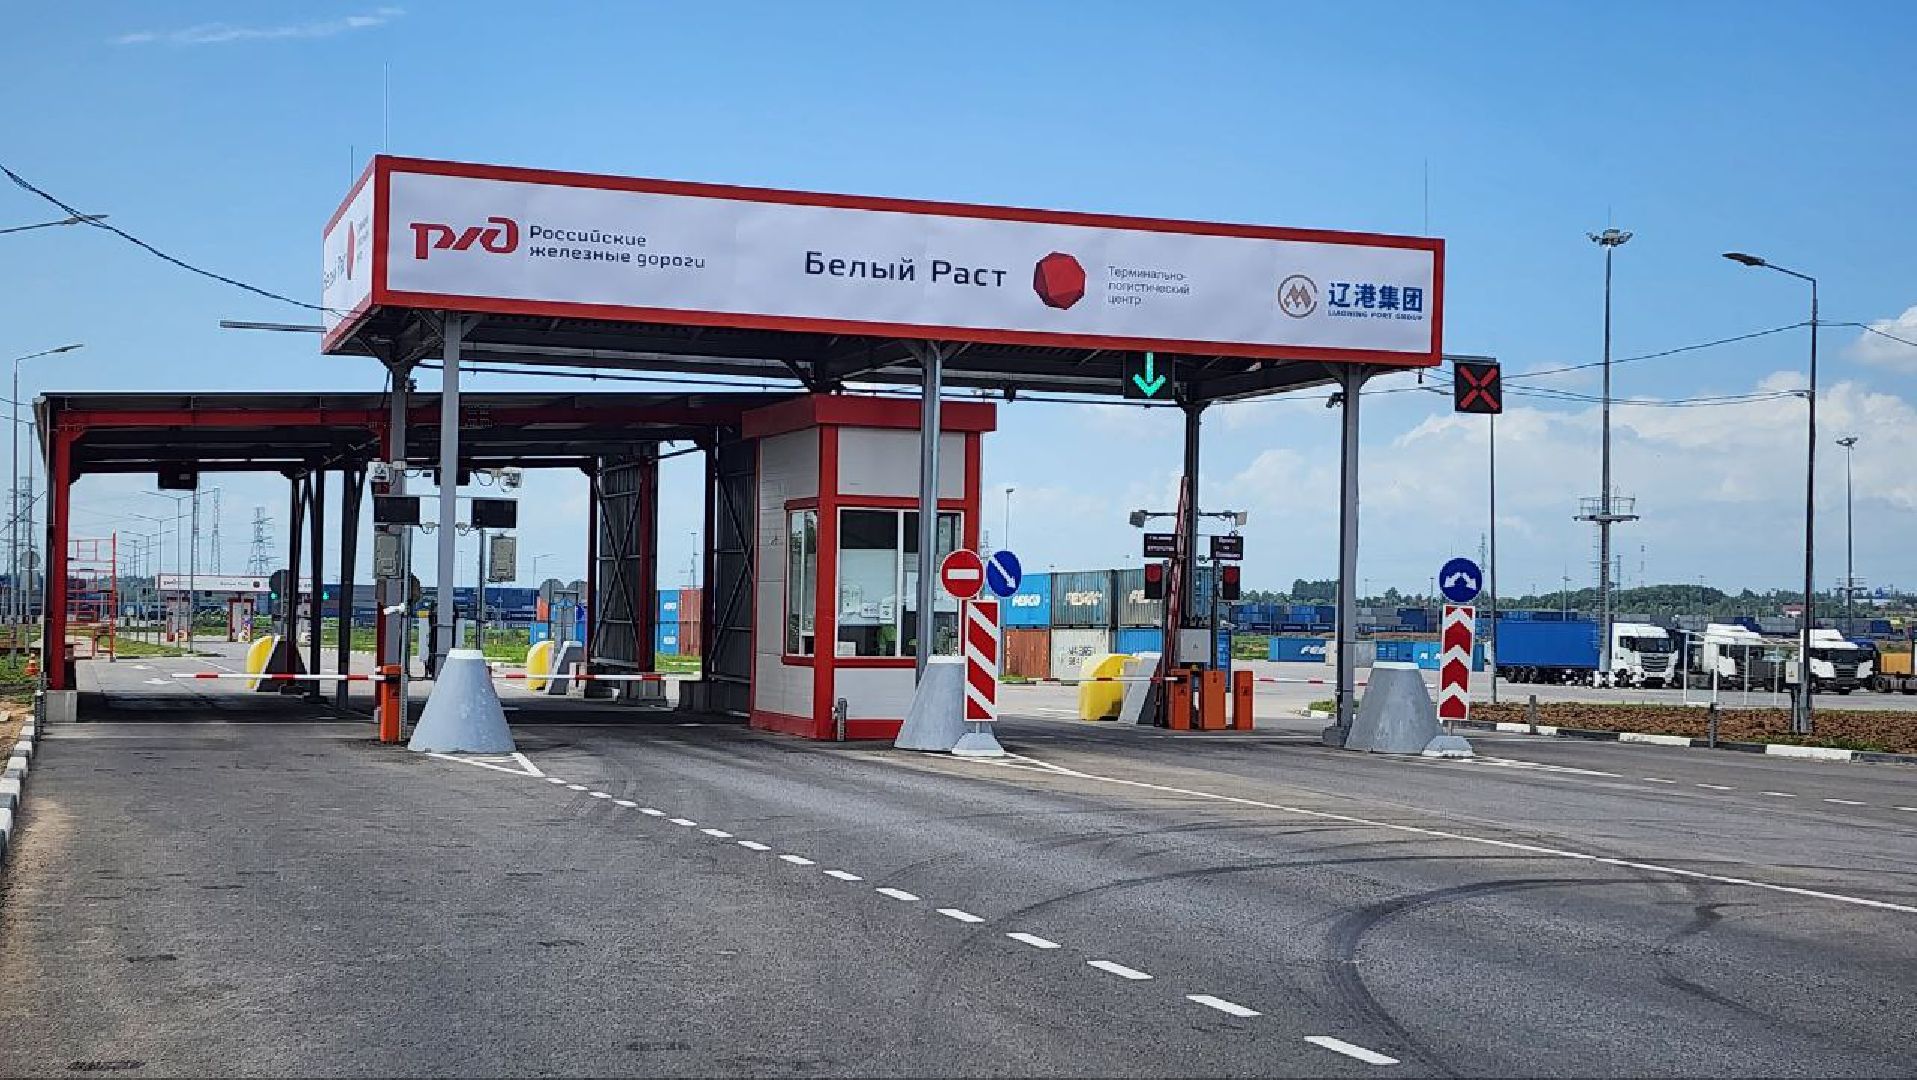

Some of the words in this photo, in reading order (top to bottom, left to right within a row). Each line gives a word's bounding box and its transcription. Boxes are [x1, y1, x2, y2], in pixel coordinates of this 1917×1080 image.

[529, 225, 647, 247] Российские
[529, 246, 631, 263] железные
[637, 252, 706, 269] дороги
[804, 250, 915, 281] Белый
[930, 259, 1007, 287] Раст
[1108, 265, 1188, 281] Терминально-
[1108, 295, 1142, 308] центр
[1328, 282, 1423, 312] 辽港集团
[1370, 312, 1393, 320] PORT
